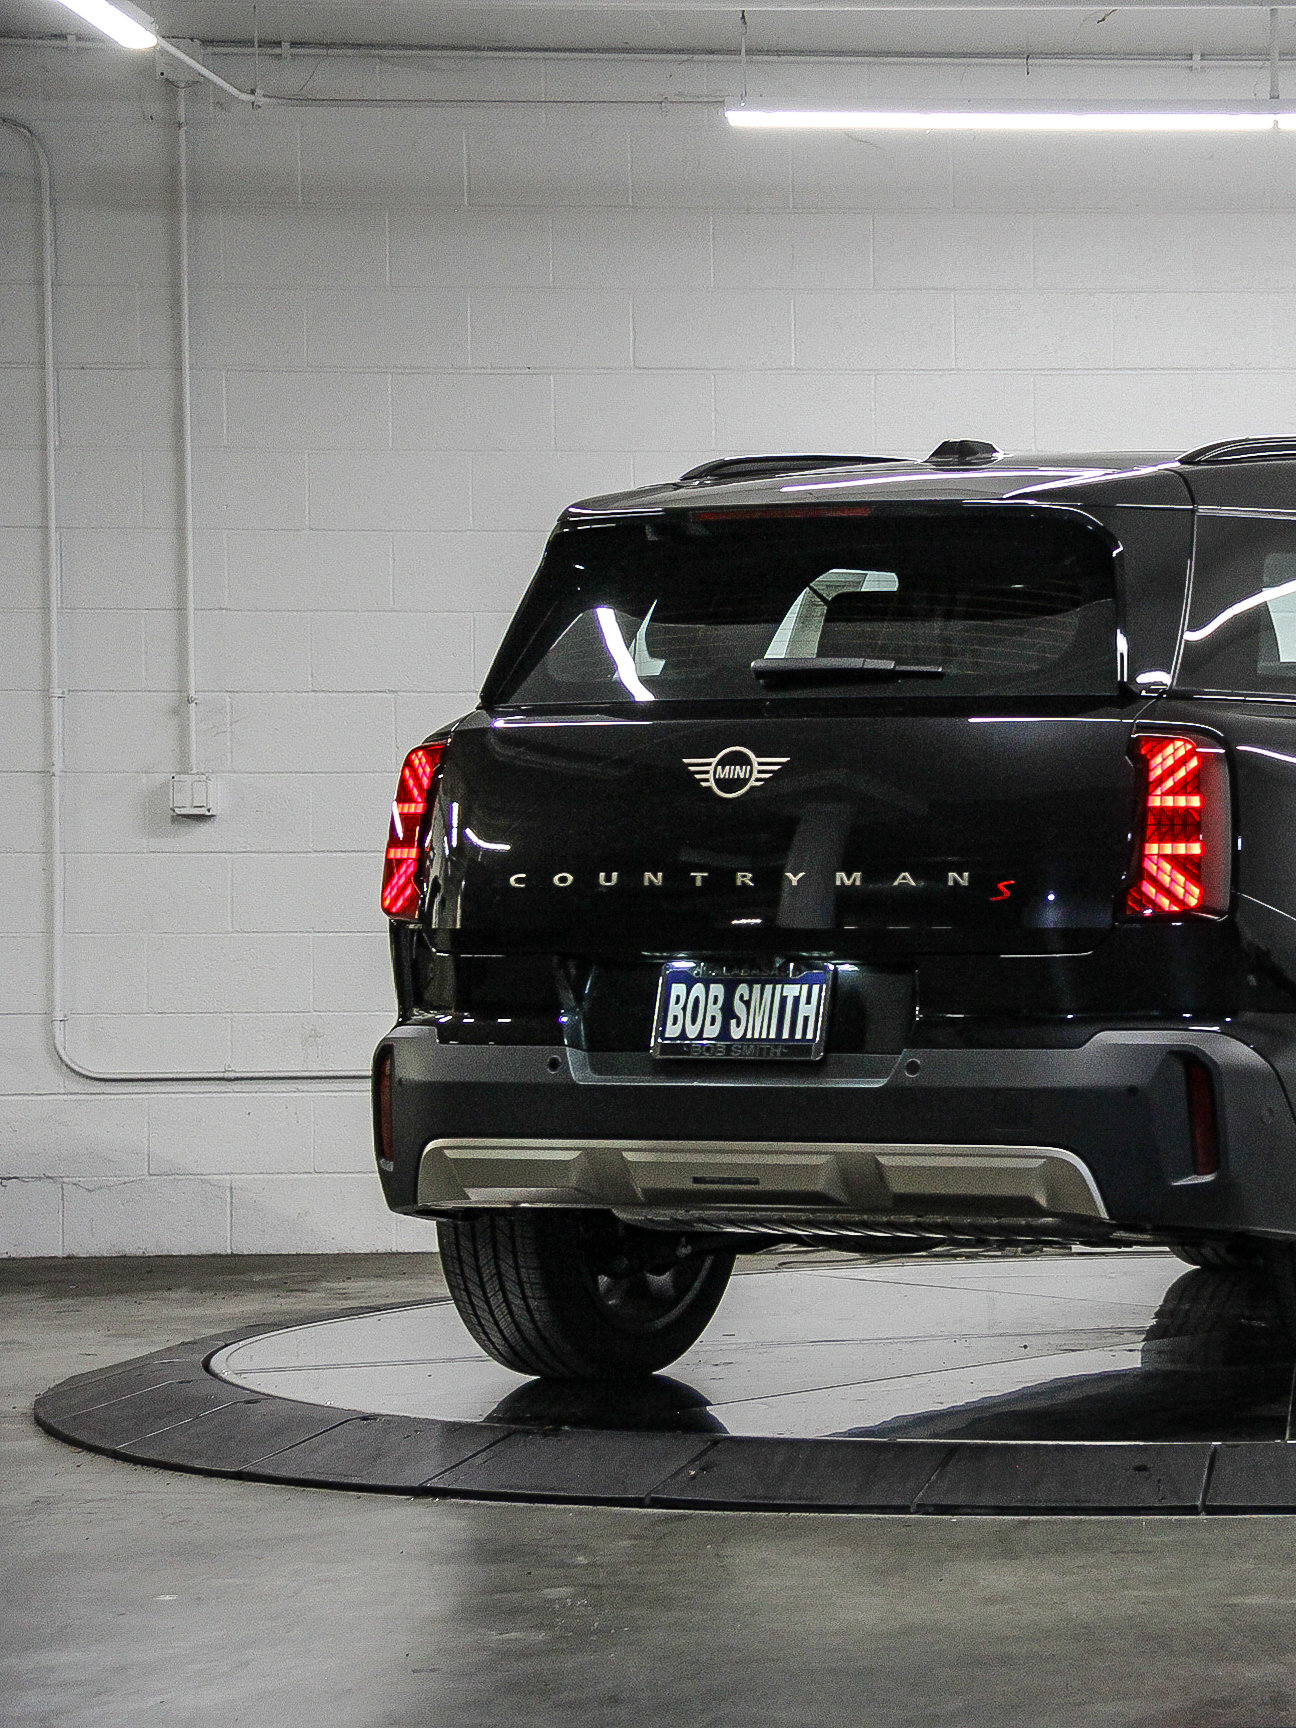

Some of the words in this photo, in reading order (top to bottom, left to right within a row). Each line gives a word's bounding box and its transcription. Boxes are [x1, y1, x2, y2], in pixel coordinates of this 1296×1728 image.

[715, 765, 751, 780] MINI
[509, 872, 970, 889] COUNTRYMAN
[988, 880, 1015, 901] S
[664, 982, 725, 1039] BOB
[729, 982, 820, 1040] SMITH
[690, 1044, 727, 1056] BOB
[731, 1045, 782, 1057] SMITH
